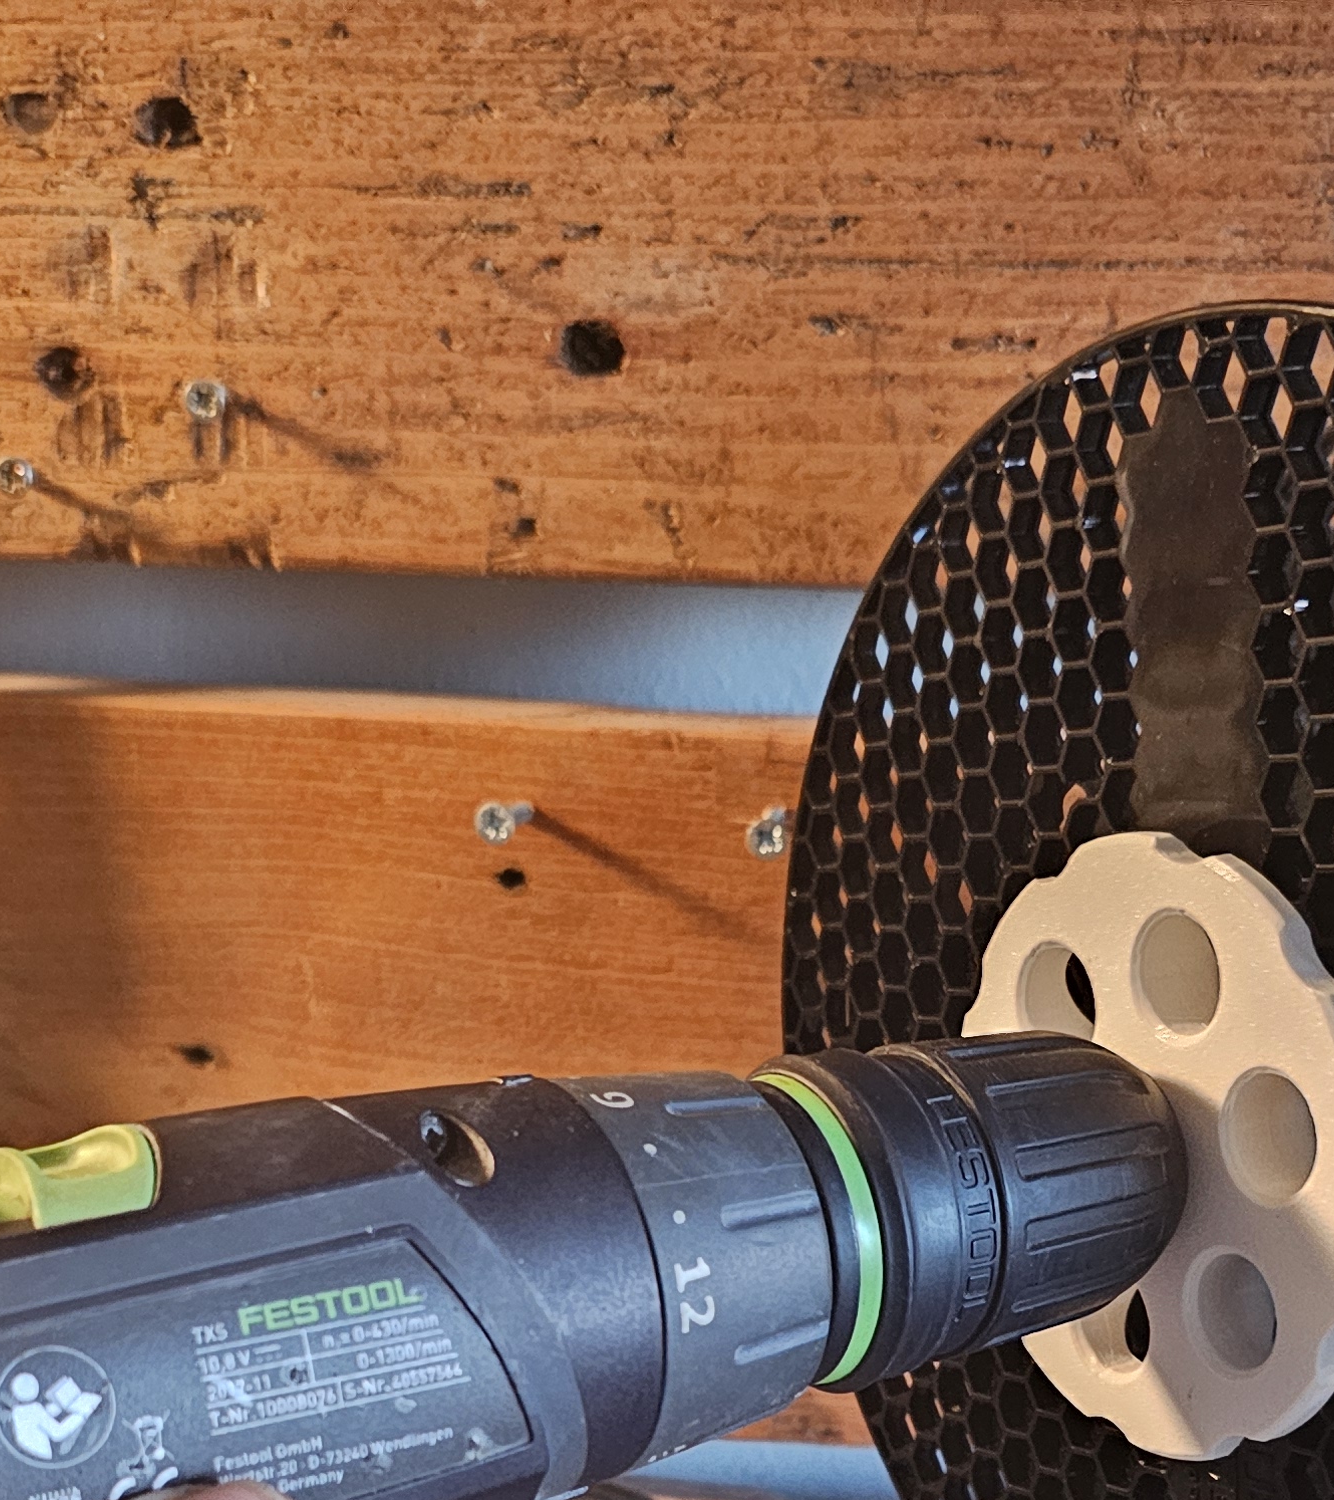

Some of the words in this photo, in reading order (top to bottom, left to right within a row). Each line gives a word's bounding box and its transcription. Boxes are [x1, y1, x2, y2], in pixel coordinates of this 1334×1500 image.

[590, 1091, 635, 1108] 9
[192, 1322, 228, 1345] TXS
[237, 1278, 426, 1336] FESTOOL
[673, 1256, 716, 1335] 12
[214, 1447, 274, 1473] Festool
[275, 1435, 324, 1460] GmbH
[278, 1469, 345, 1494] Germany
